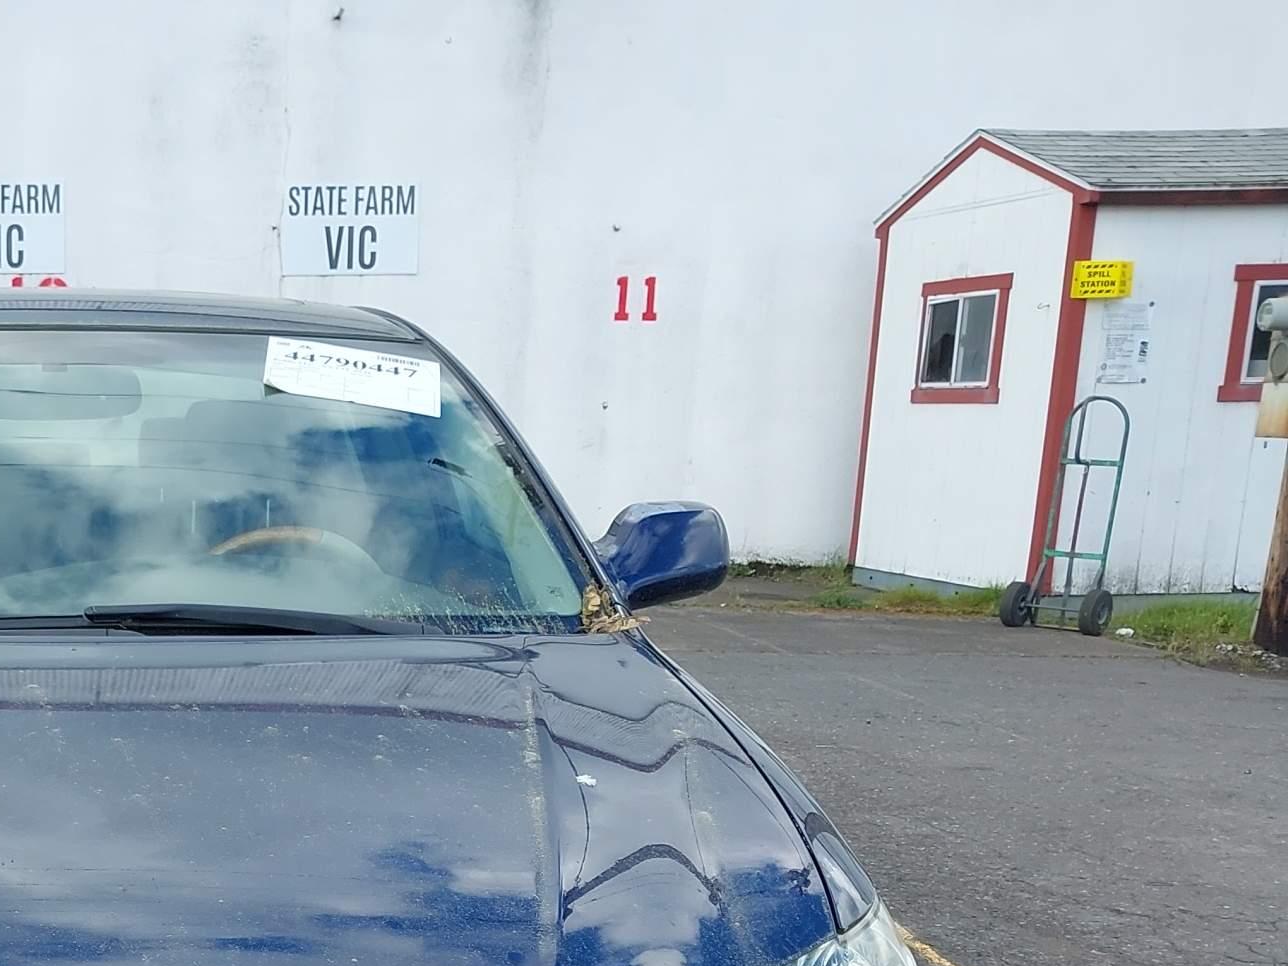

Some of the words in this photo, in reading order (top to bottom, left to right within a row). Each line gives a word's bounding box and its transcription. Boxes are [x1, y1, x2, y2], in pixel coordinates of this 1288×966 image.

[0, 184, 61, 214] FARM
[288, 186, 348, 216] STATE
[354, 185, 416, 216] FARM
[324, 225, 377, 270] VIC
[614, 276, 657, 321] 11
[1080, 280, 1116, 288] STATION
[284, 351, 418, 378] 44790447
